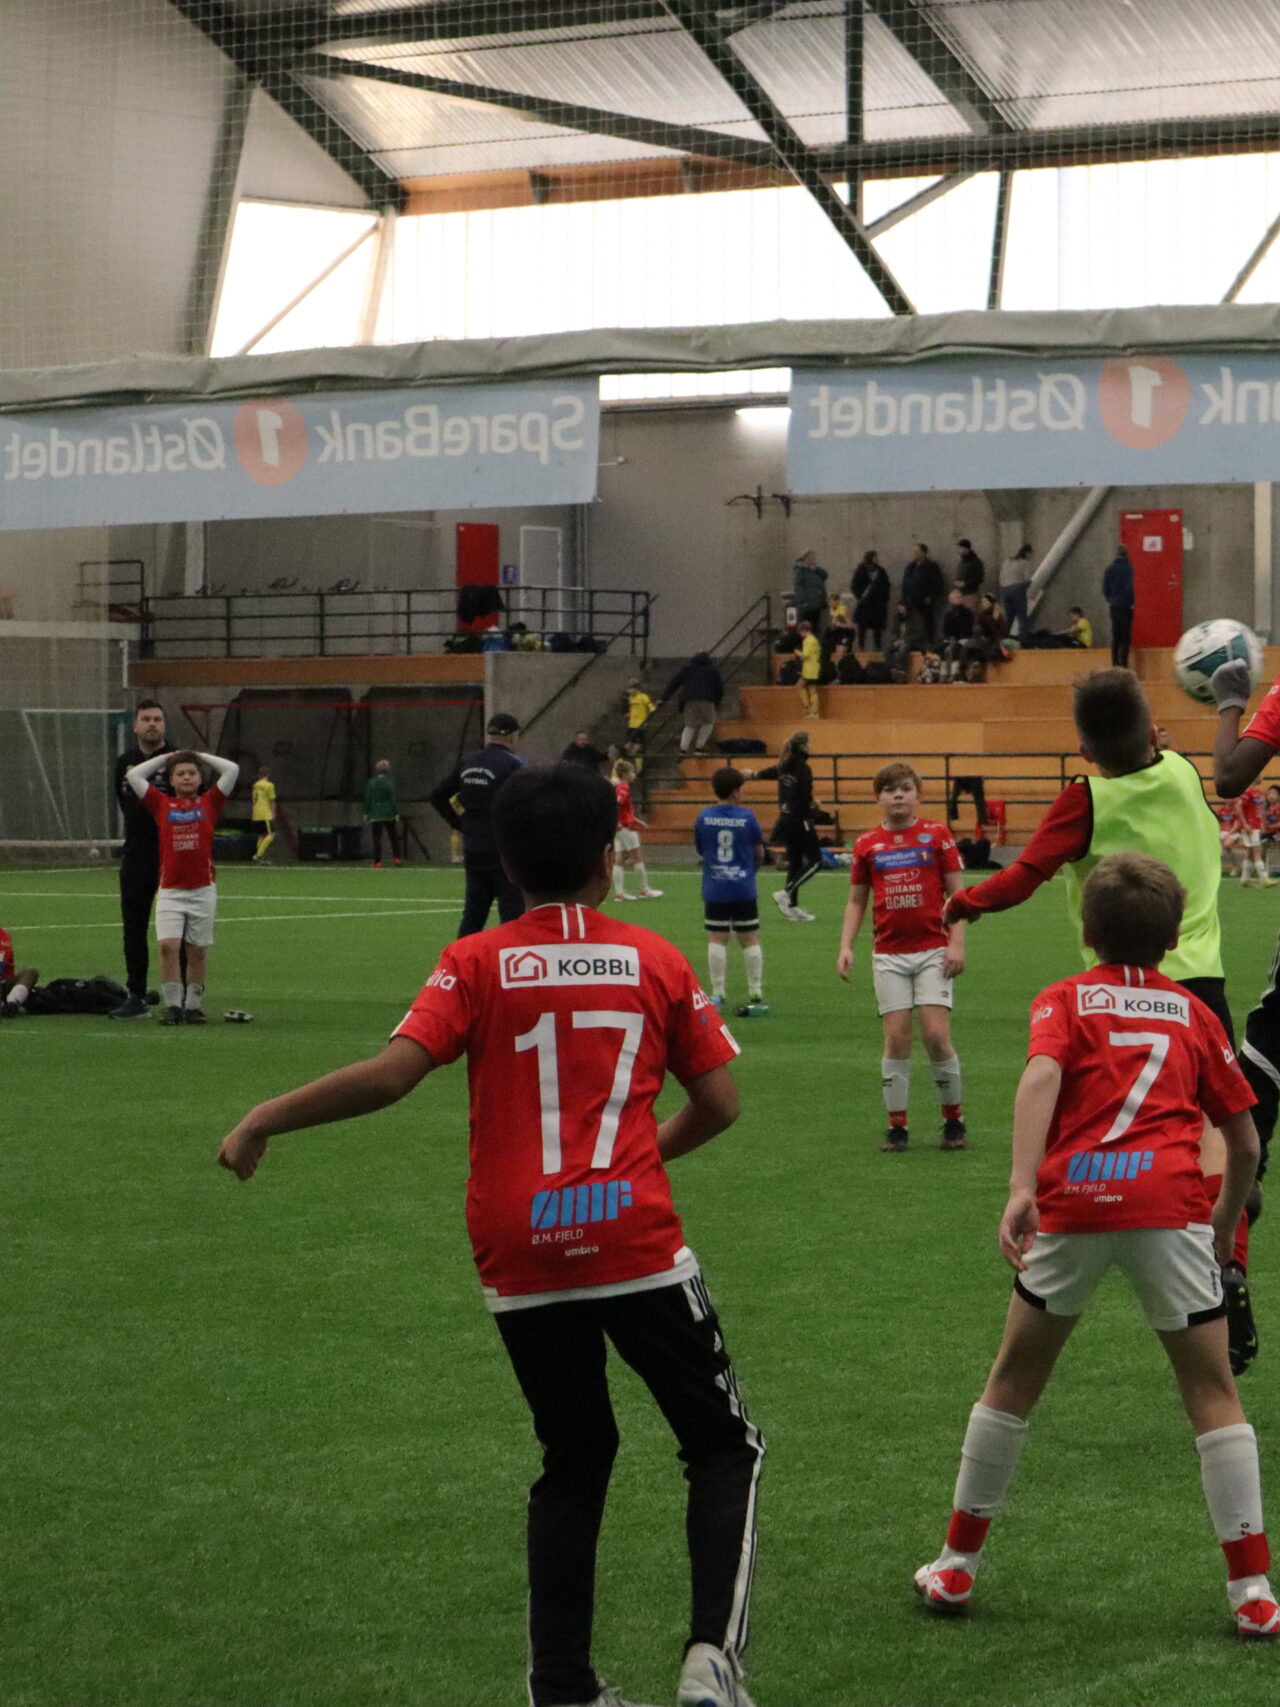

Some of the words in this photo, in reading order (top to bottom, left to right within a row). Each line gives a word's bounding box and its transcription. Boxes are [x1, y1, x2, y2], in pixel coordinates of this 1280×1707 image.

[717, 829, 734, 863] 8
[558, 959, 635, 977] KOBBL
[1124, 999, 1187, 1019] KOBBL
[514, 1009, 645, 1175] 17
[1101, 1031, 1170, 1143] 7
[1094, 1194, 1123, 1203] umbro
[555, 1228, 584, 1243] FJELD
[564, 1245, 599, 1257] umbro
